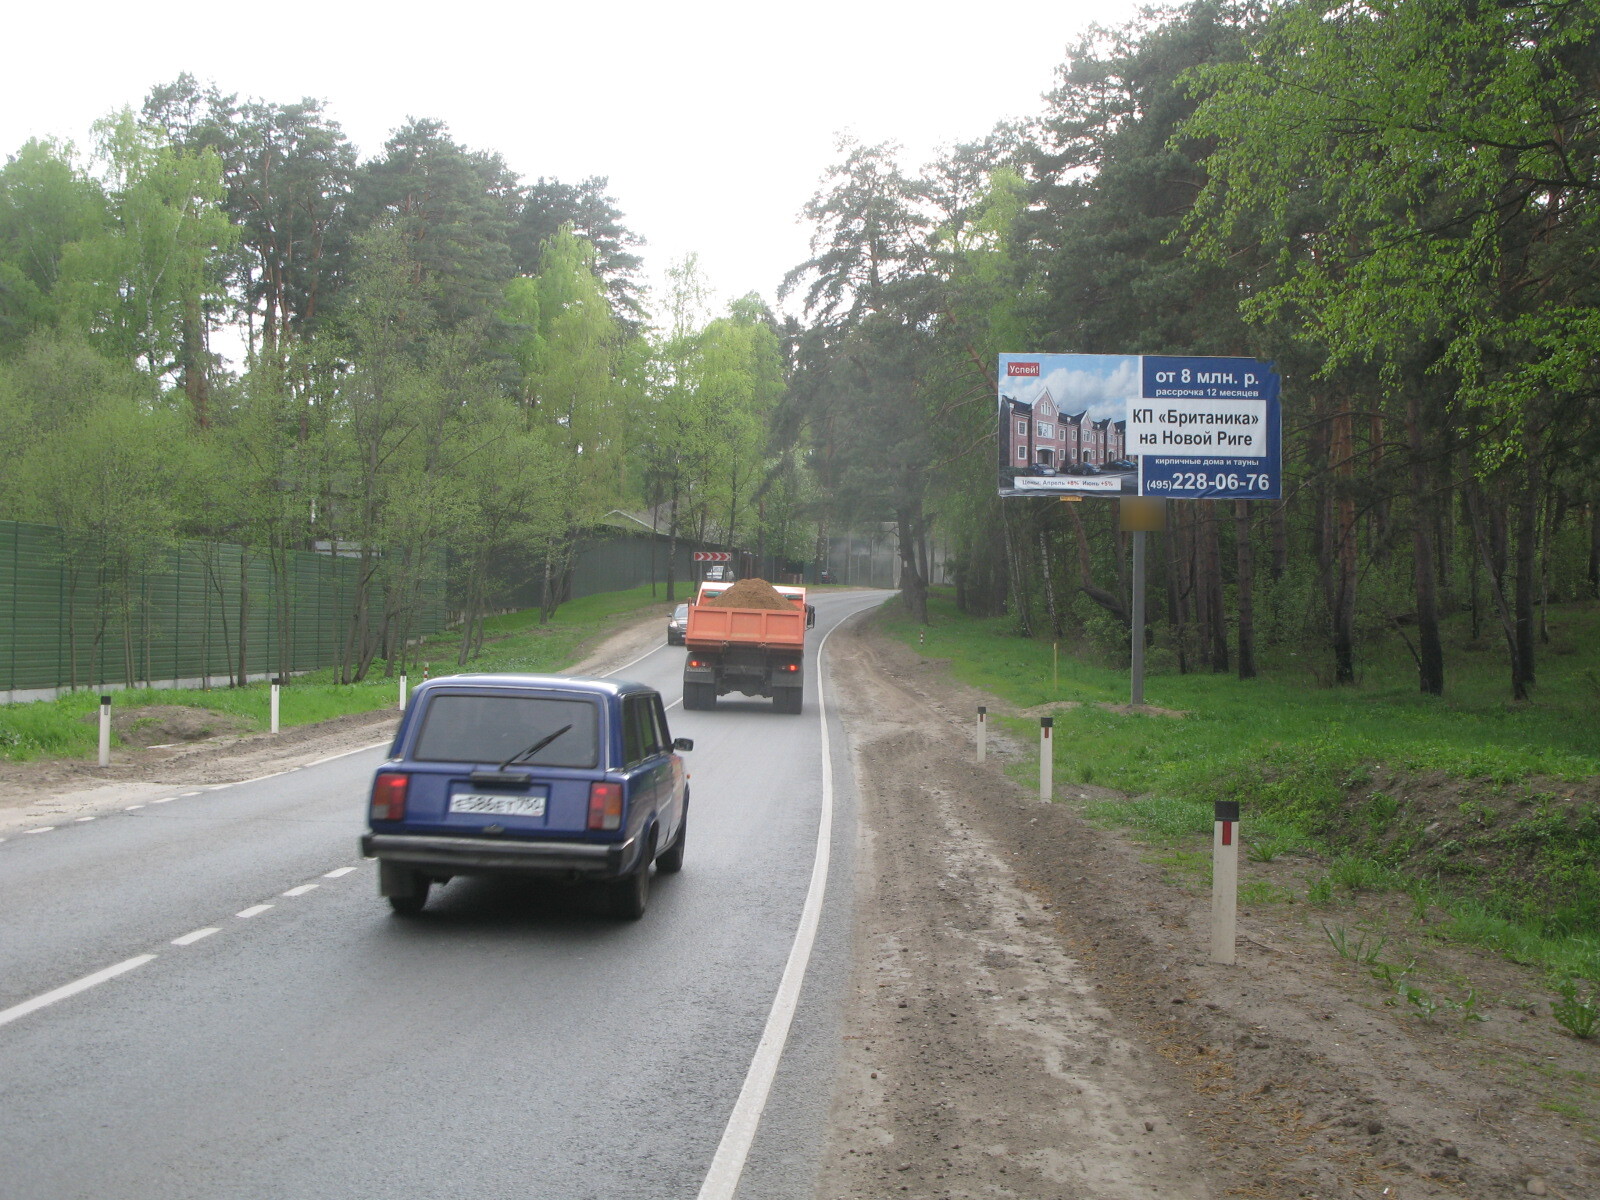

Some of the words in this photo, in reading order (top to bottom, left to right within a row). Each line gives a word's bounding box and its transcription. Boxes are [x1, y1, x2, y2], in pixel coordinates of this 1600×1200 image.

[1010, 365, 1039, 374] Успей!
[1155, 371, 1176, 383] от
[1180, 368, 1191, 383] 8
[1197, 371, 1238, 384] млн.
[1244, 372, 1259, 388] р.
[1155, 388, 1204, 397] рассрочка
[1206, 388, 1217, 396] 12
[1219, 389, 1259, 398] месяцев
[1132, 408, 1153, 424] КП
[1158, 409, 1259, 427] «Британика»
[1139, 433, 1157, 445] на
[1162, 430, 1212, 445] Новой
[1217, 430, 1253, 446] Риге
[1155, 458, 1202, 466] кирпичные
[1202, 458, 1224, 466] дома
[1233, 459, 1259, 467] тауны
[1146, 479, 1172, 492] (495)
[1172, 472, 1270, 491] 228-06-76
